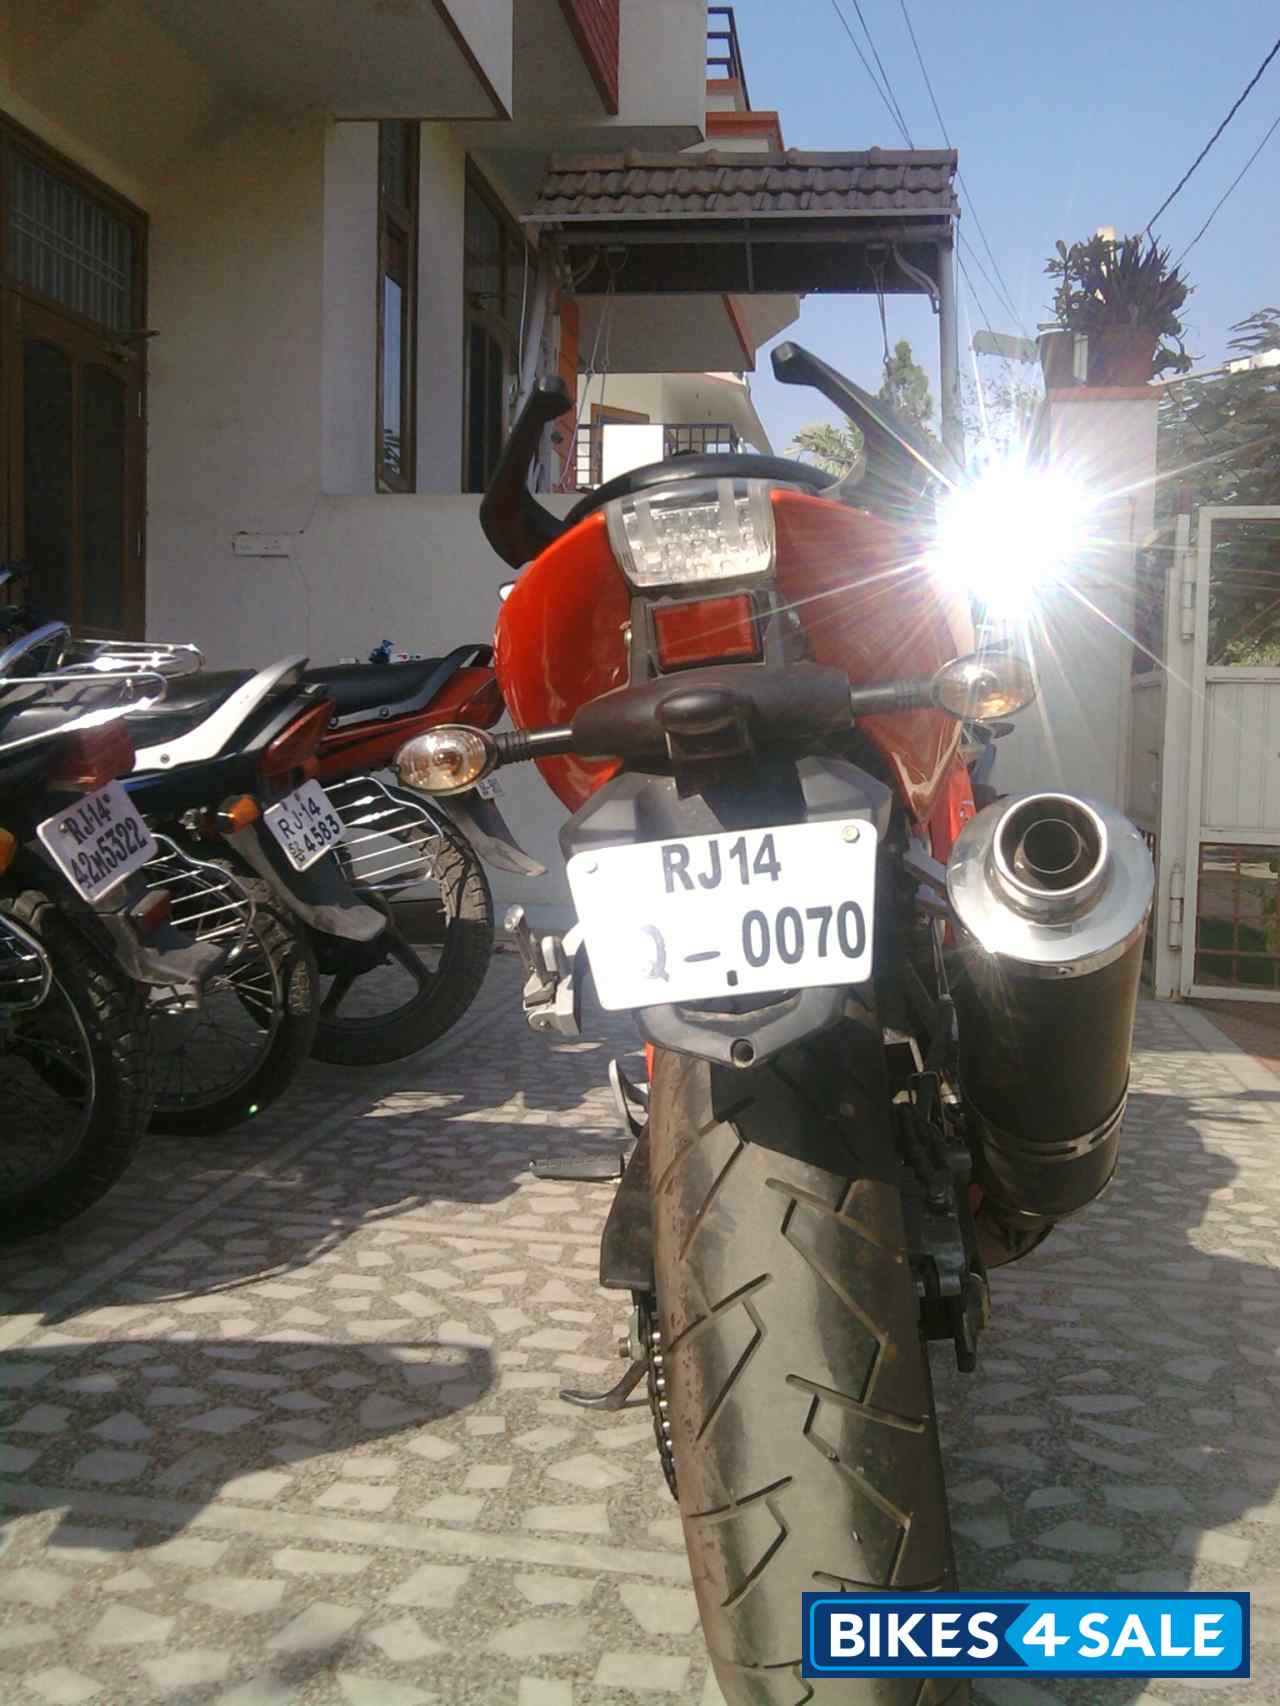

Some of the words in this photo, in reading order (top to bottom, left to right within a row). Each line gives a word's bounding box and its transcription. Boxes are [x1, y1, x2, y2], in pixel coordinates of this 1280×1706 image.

[303, 814, 340, 852] 4583
[660, 833, 782, 893] RJ14
[741, 900, 866, 968] 0070
